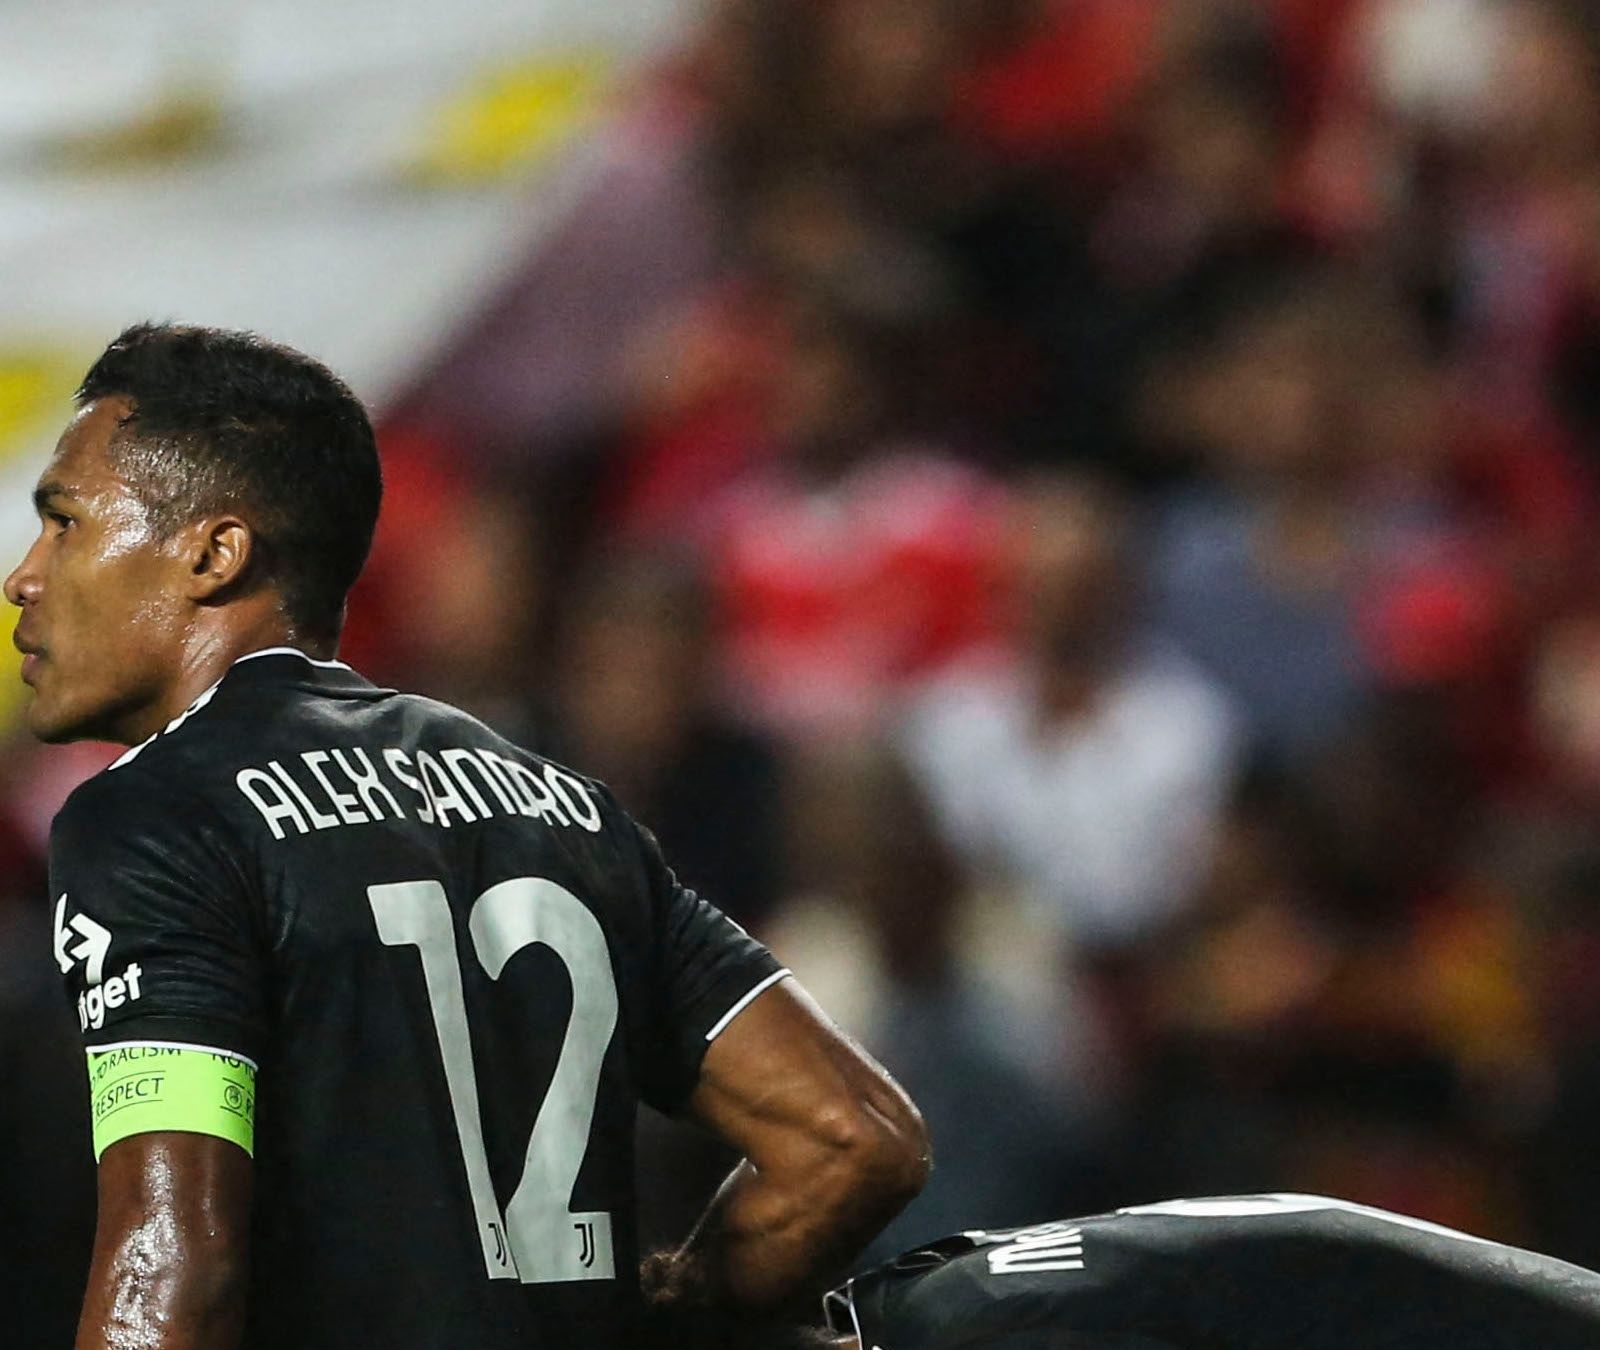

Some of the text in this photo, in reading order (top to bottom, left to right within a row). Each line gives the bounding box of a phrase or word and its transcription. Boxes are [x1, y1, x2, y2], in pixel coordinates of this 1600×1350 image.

[236, 747, 602, 840] ALEX SANDRO
[95, 1077, 165, 1119] RESPECT
[366, 876, 617, 1284] 12
